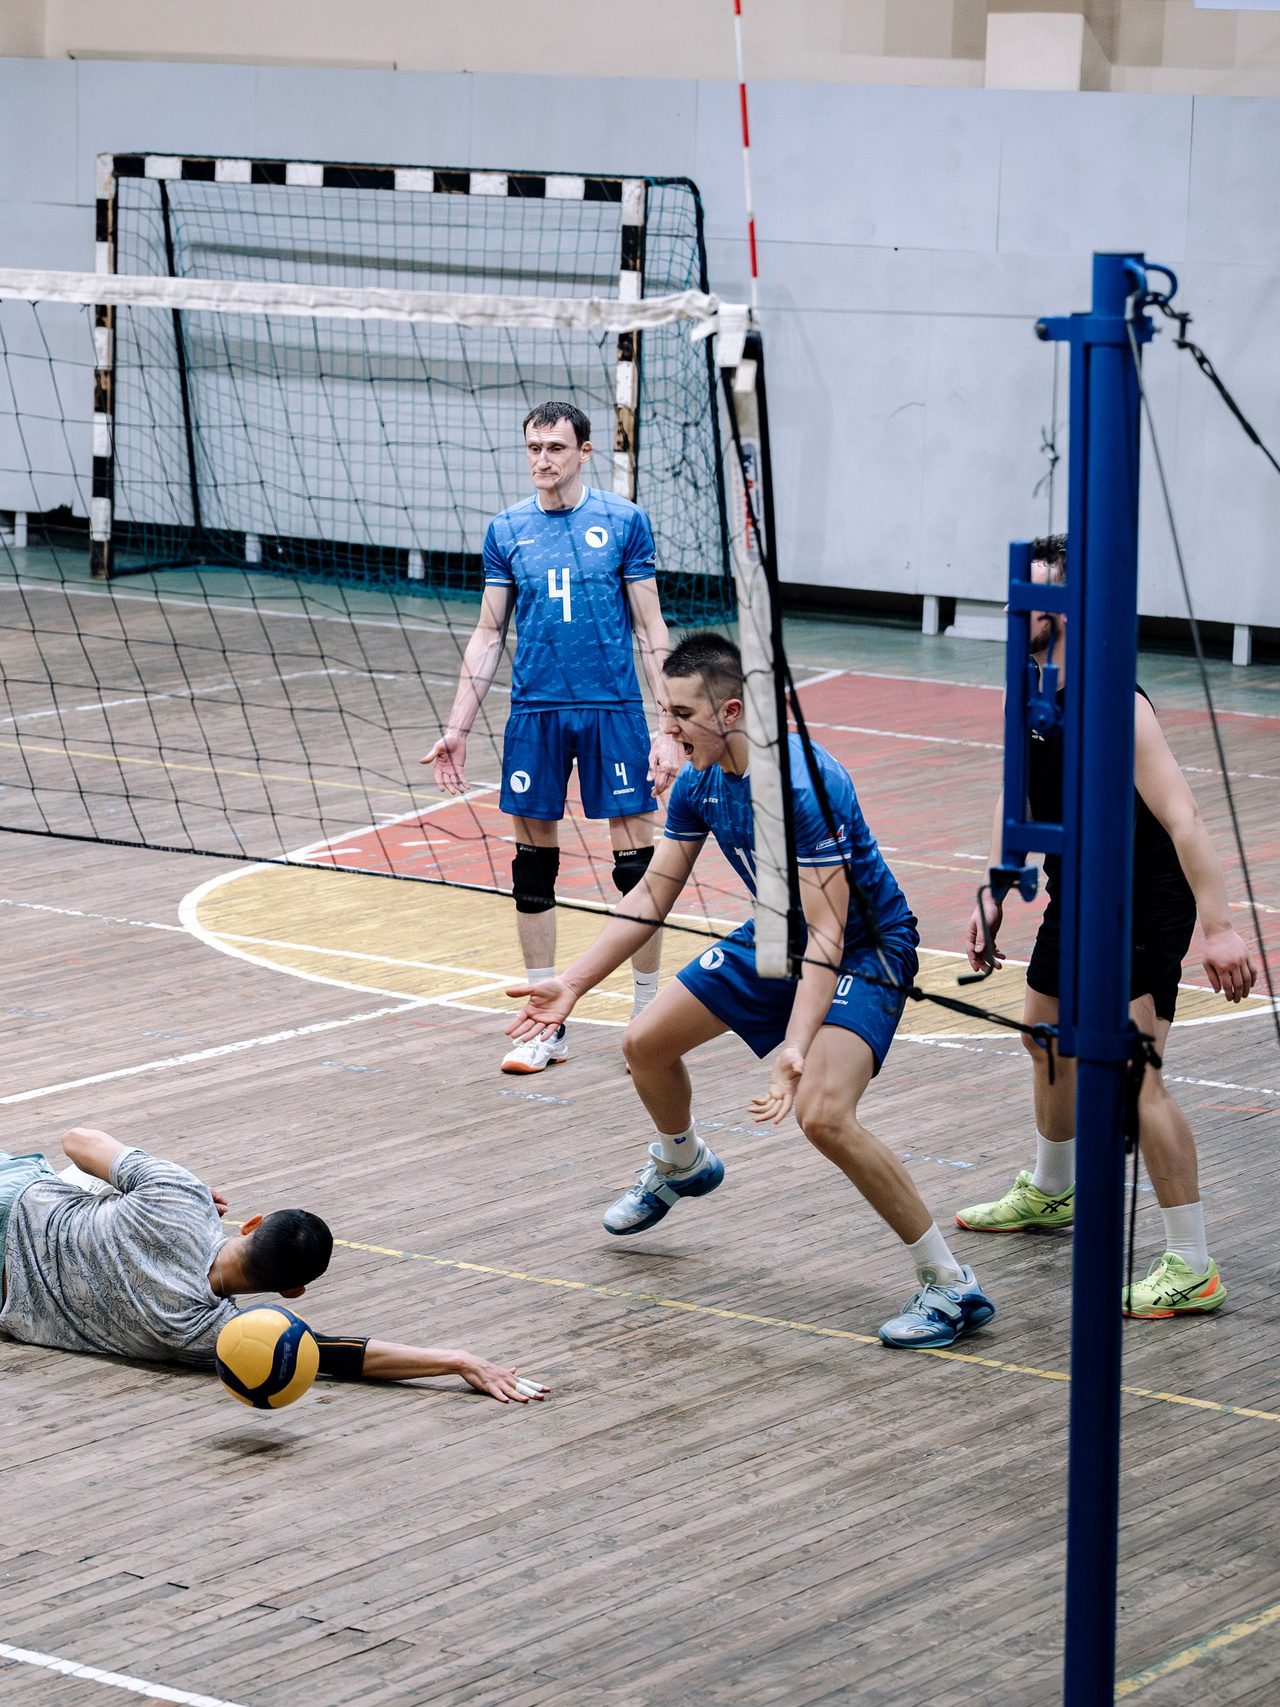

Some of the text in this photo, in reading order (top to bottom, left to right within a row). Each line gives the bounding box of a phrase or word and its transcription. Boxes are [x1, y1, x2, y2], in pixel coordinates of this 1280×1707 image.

[547, 567, 572, 622] 4
[614, 762, 628, 786] 4
[734, 847, 757, 889] 1
